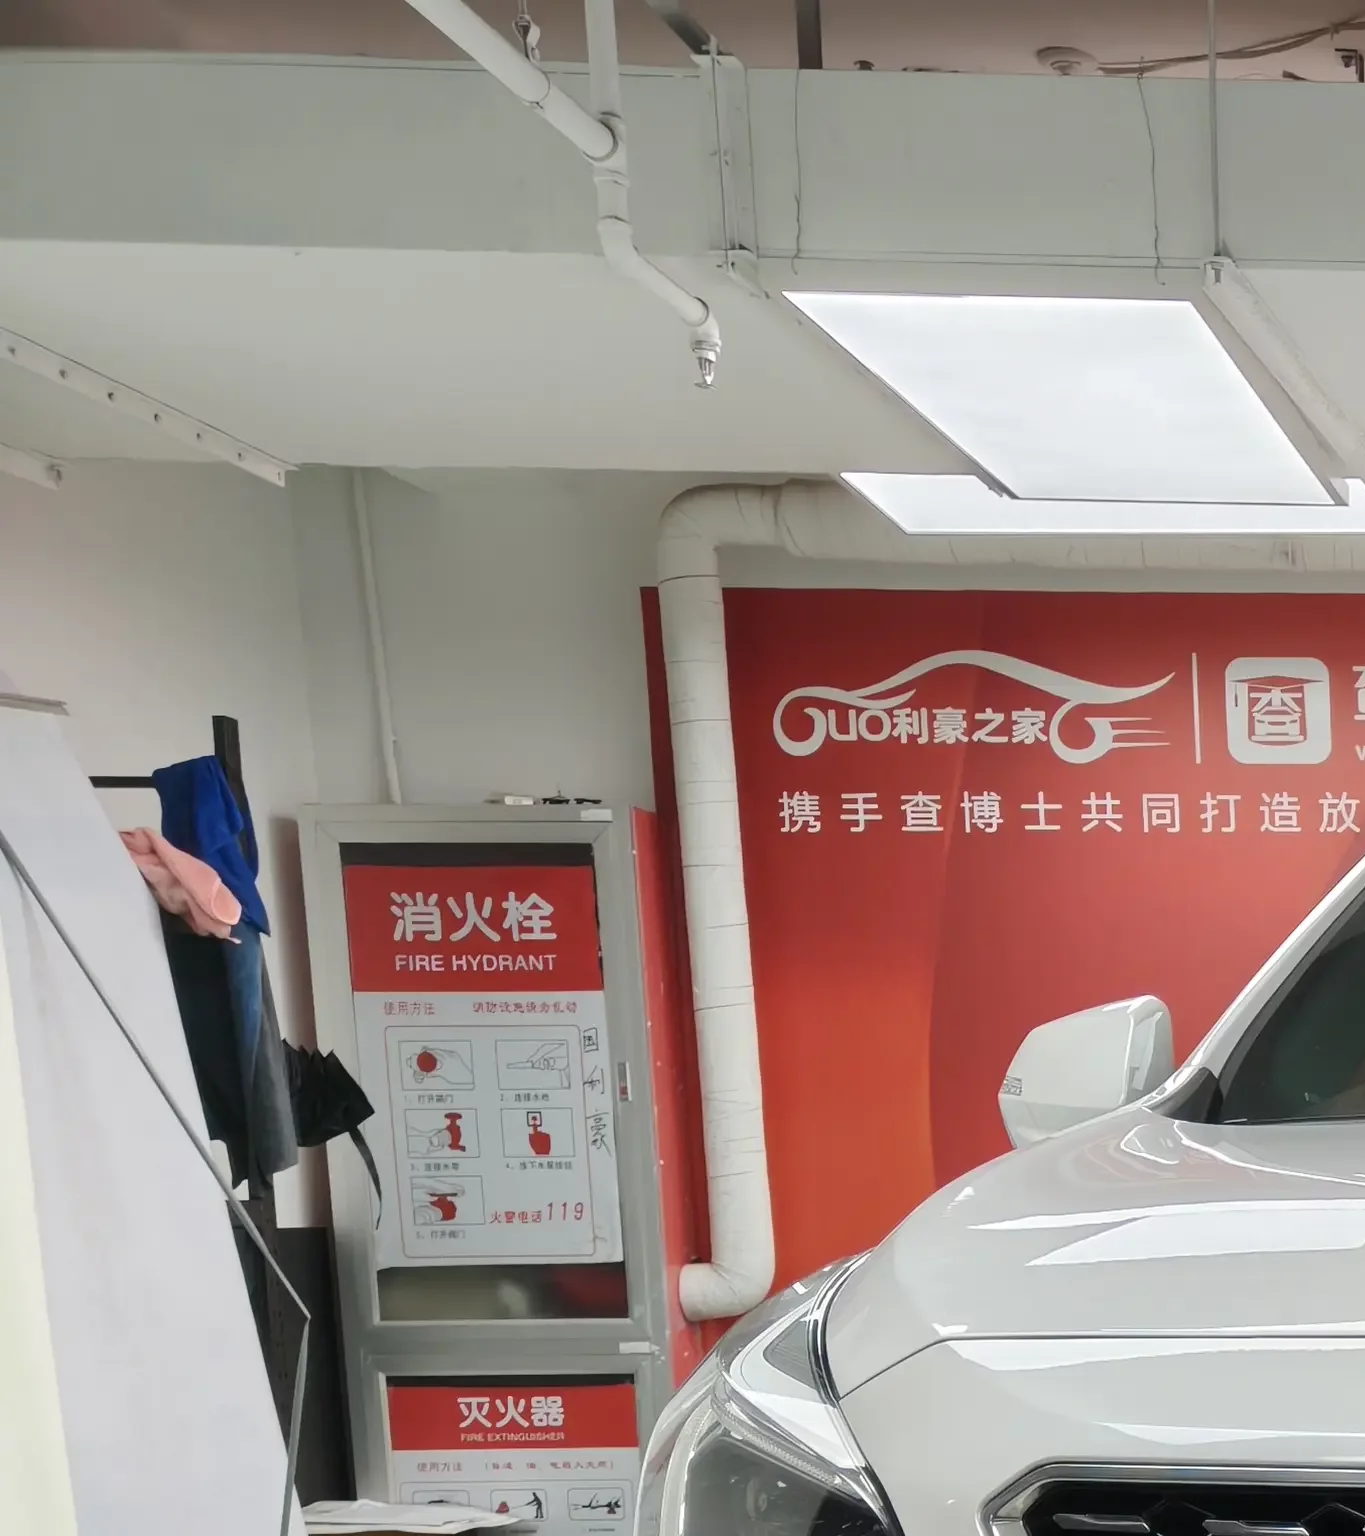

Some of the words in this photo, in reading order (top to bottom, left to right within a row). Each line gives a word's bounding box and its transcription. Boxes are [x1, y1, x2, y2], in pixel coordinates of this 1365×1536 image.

[390, 891, 557, 942] 消火栓
[395, 955, 445, 972] FIRE
[452, 954, 557, 972] HYDRANT
[457, 1396, 564, 1428] 灭火器
[461, 1433, 485, 1442] FIRE
